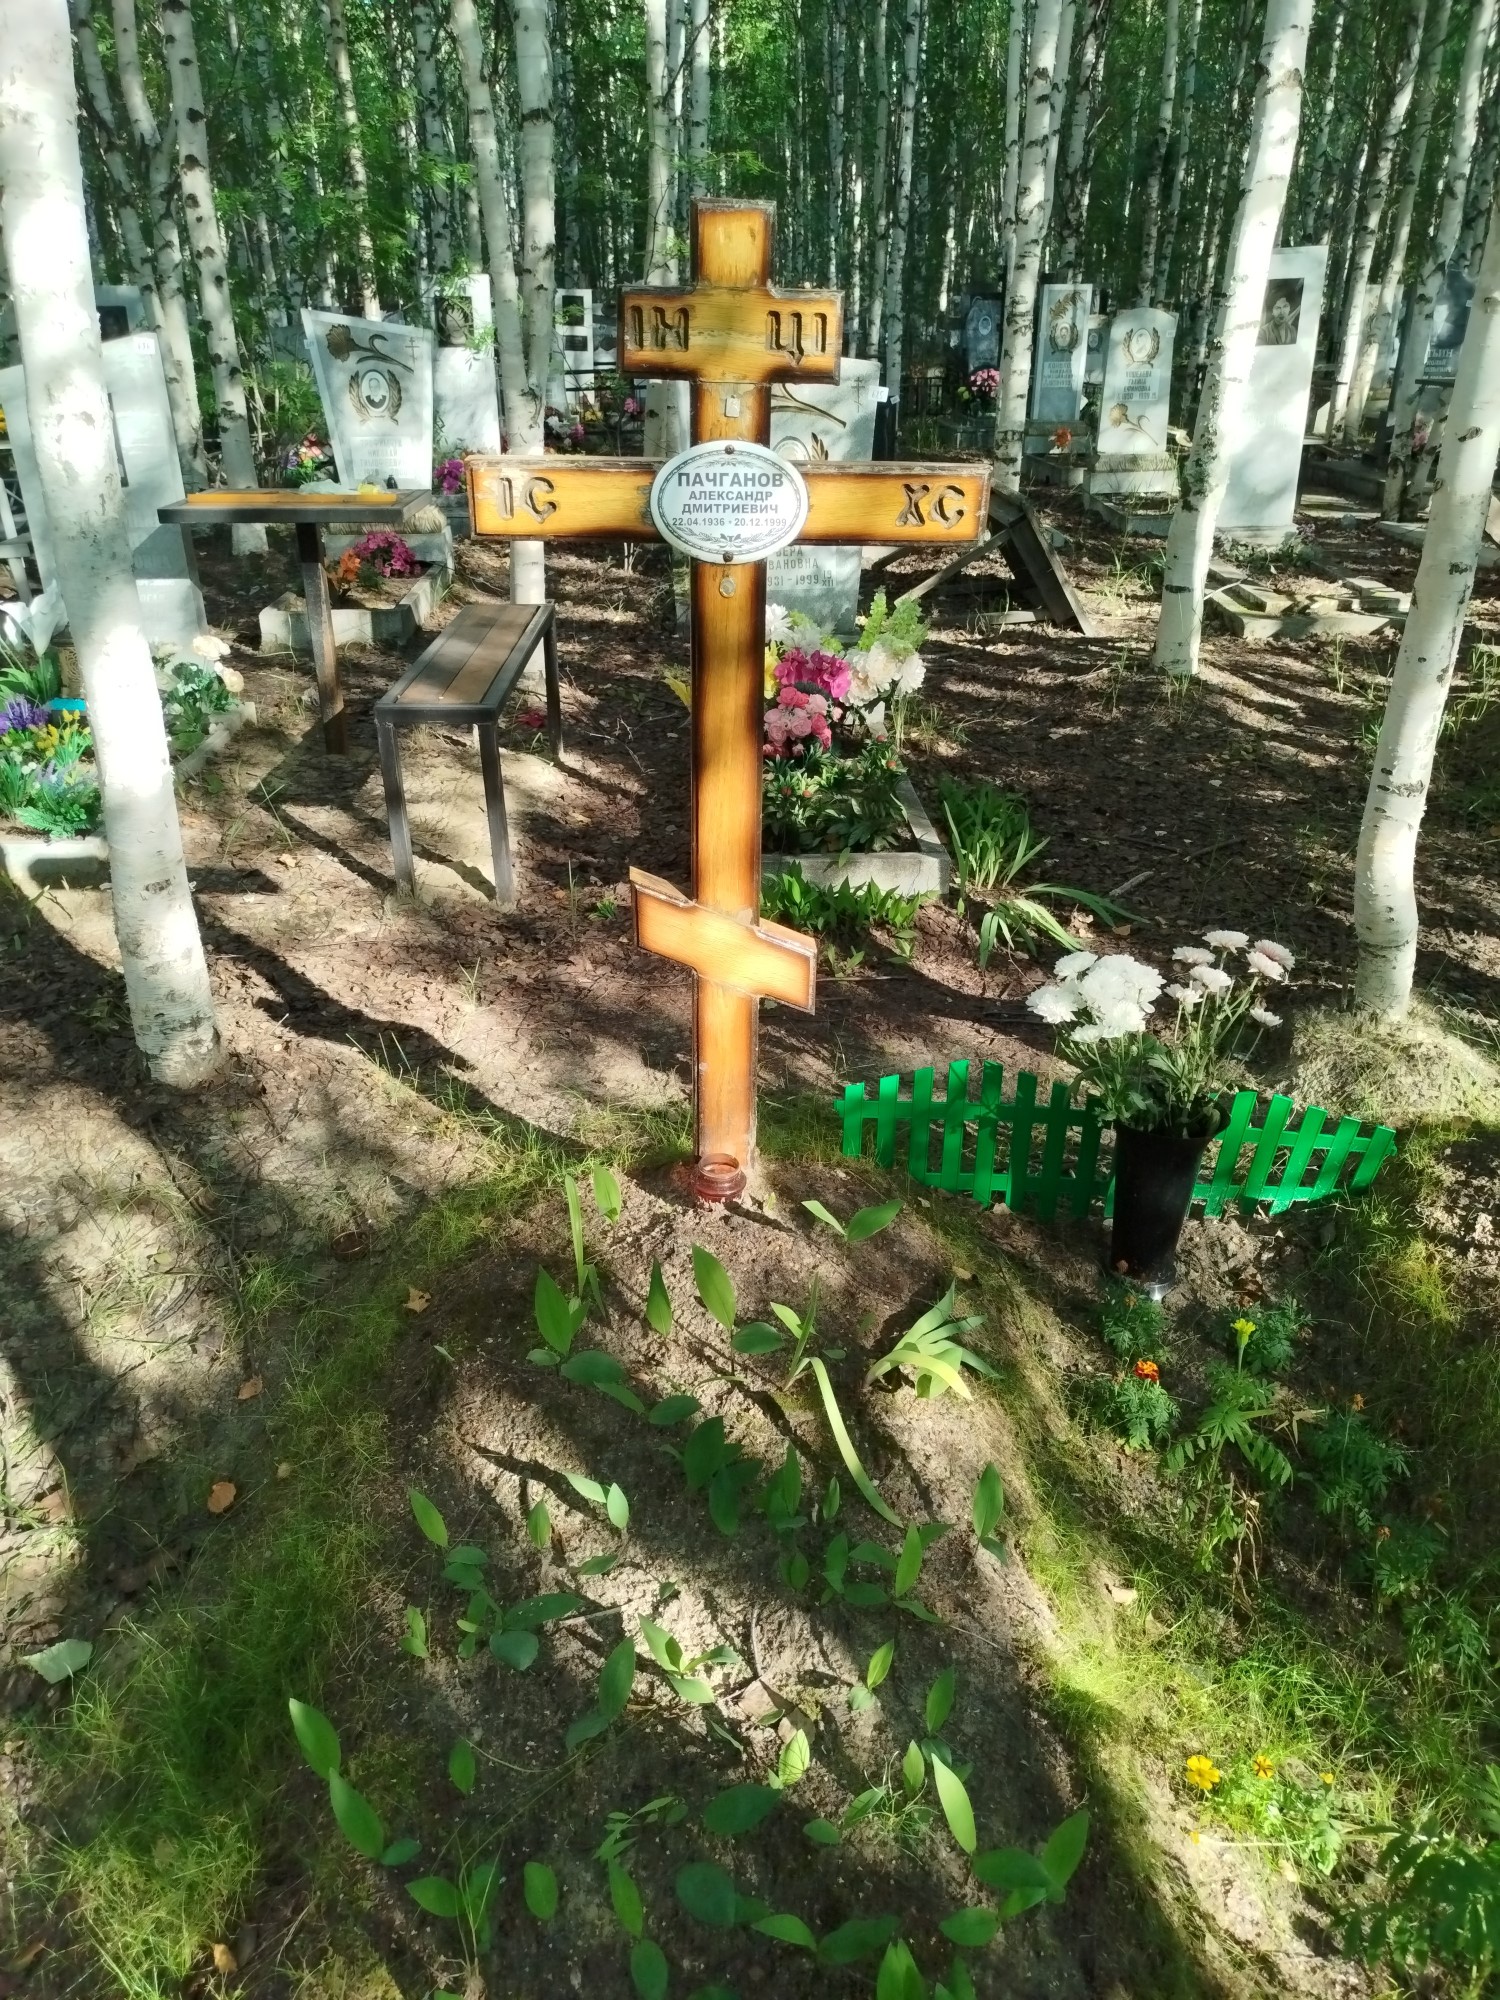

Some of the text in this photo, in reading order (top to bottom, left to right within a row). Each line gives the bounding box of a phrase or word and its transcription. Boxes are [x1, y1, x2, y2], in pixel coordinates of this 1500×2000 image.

[677, 472, 784, 488] ПАЧГАНОВ
[688, 490, 773, 503] АЛЕКСАНДР
[681, 503, 779, 515] ДМИТРИЕВИЧ
[672, 517, 726, 527] 22.04.1936
[734, 518, 787, 527] 20.12.1999
[768, 557, 819, 570] ВАНОВНА
[767, 575, 784, 587] 931
[795, 574, 819, 585] 1999
